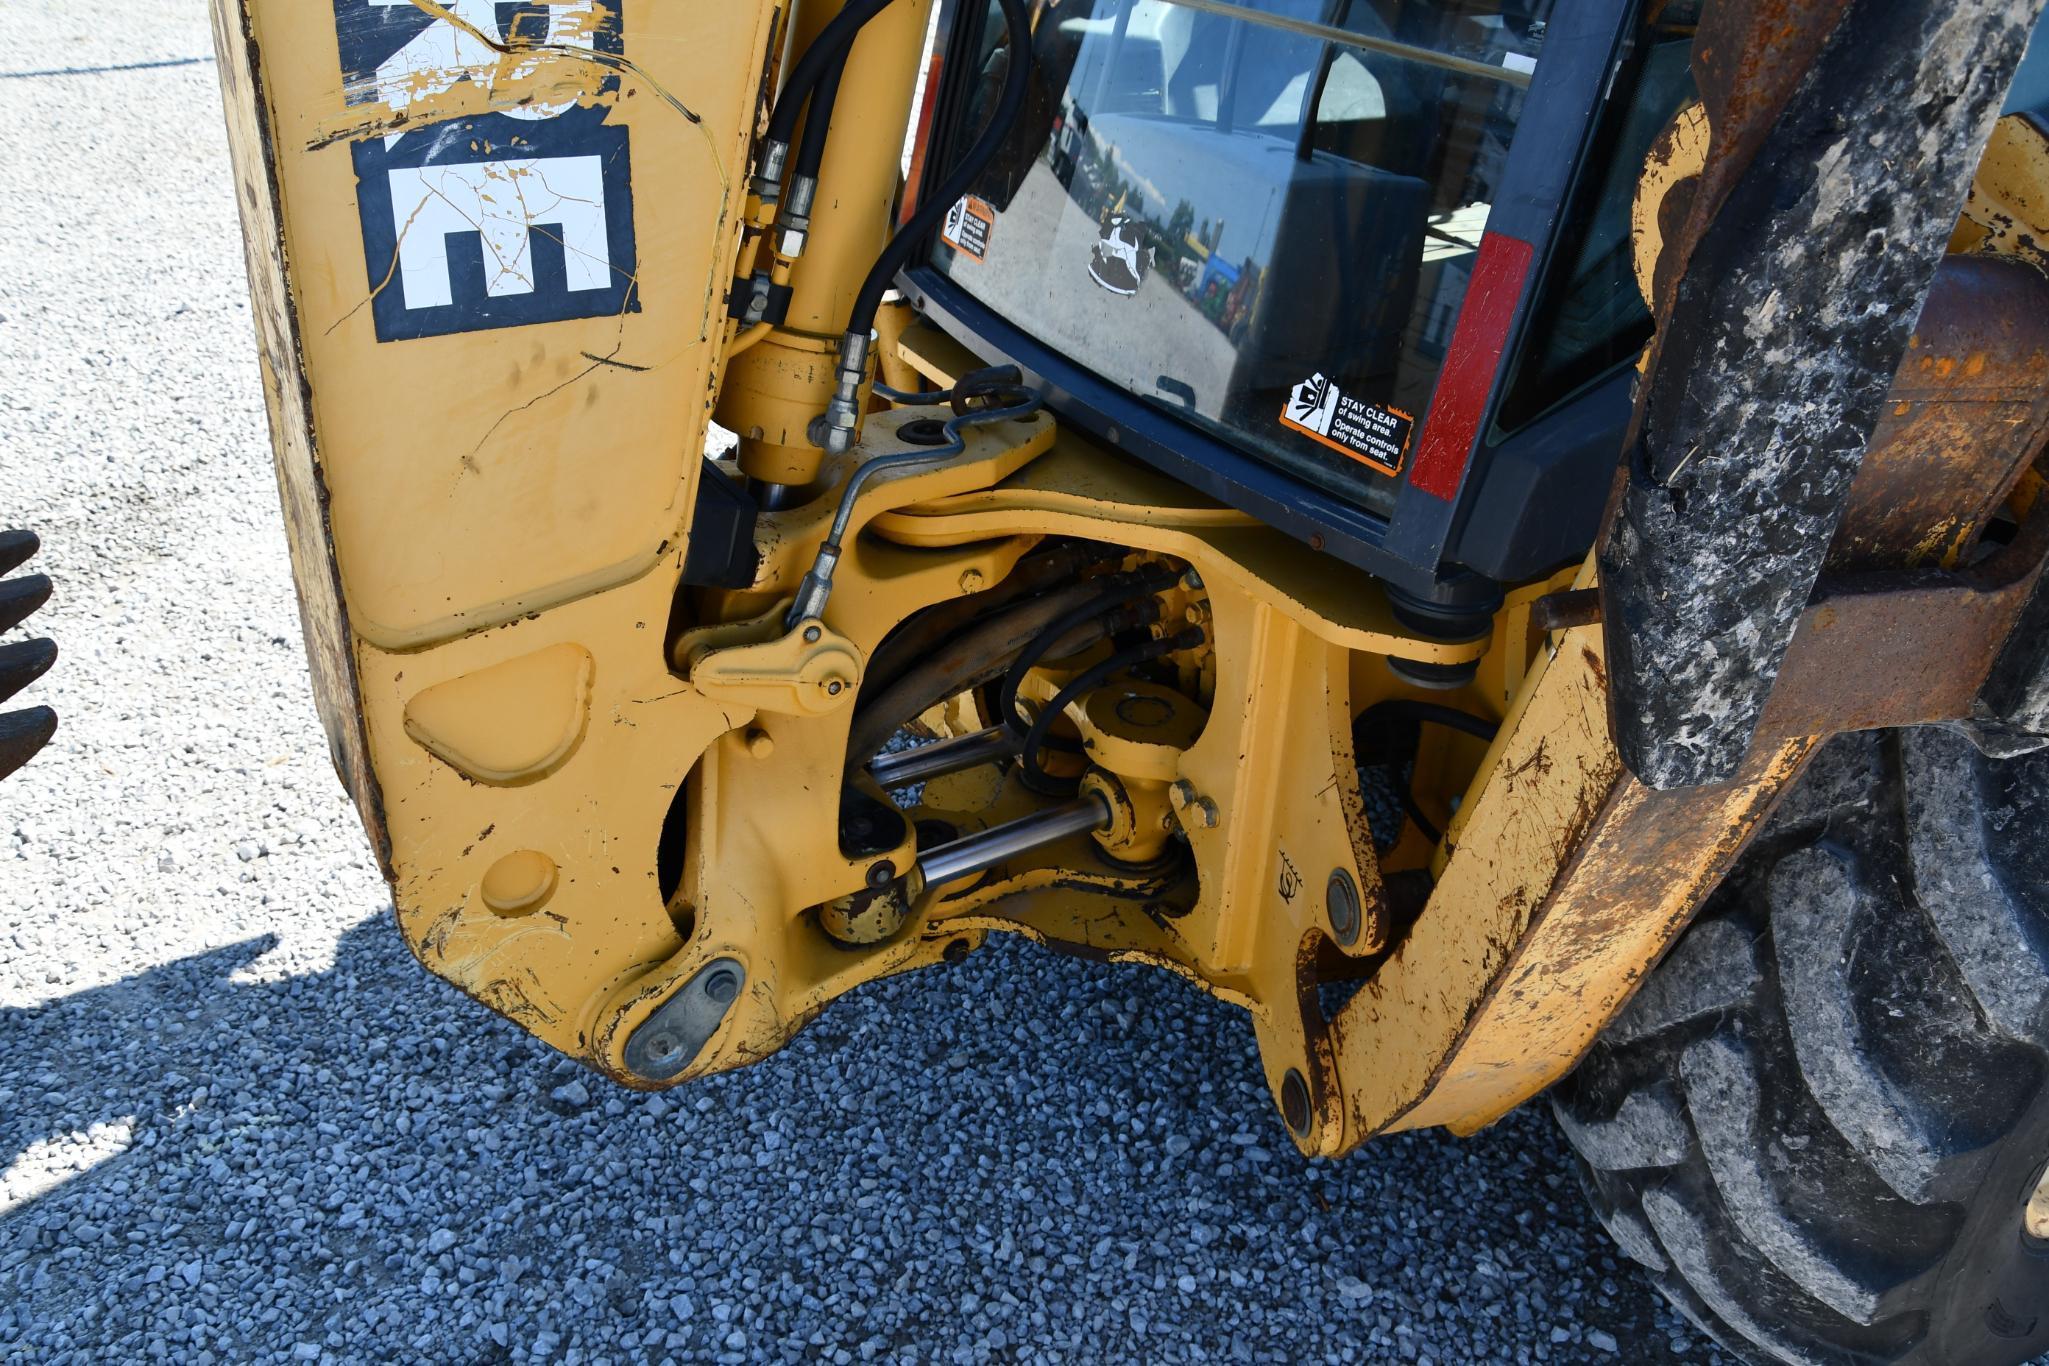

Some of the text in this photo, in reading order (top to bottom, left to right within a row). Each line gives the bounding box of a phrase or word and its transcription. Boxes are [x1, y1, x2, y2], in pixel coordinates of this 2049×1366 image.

[1338, 407, 1392, 438] of swing area.
[1341, 396, 1398, 429] STAY CLEAR
[1331, 429, 1388, 461] only from seat.
[1334, 418, 1399, 455] Operate controls
